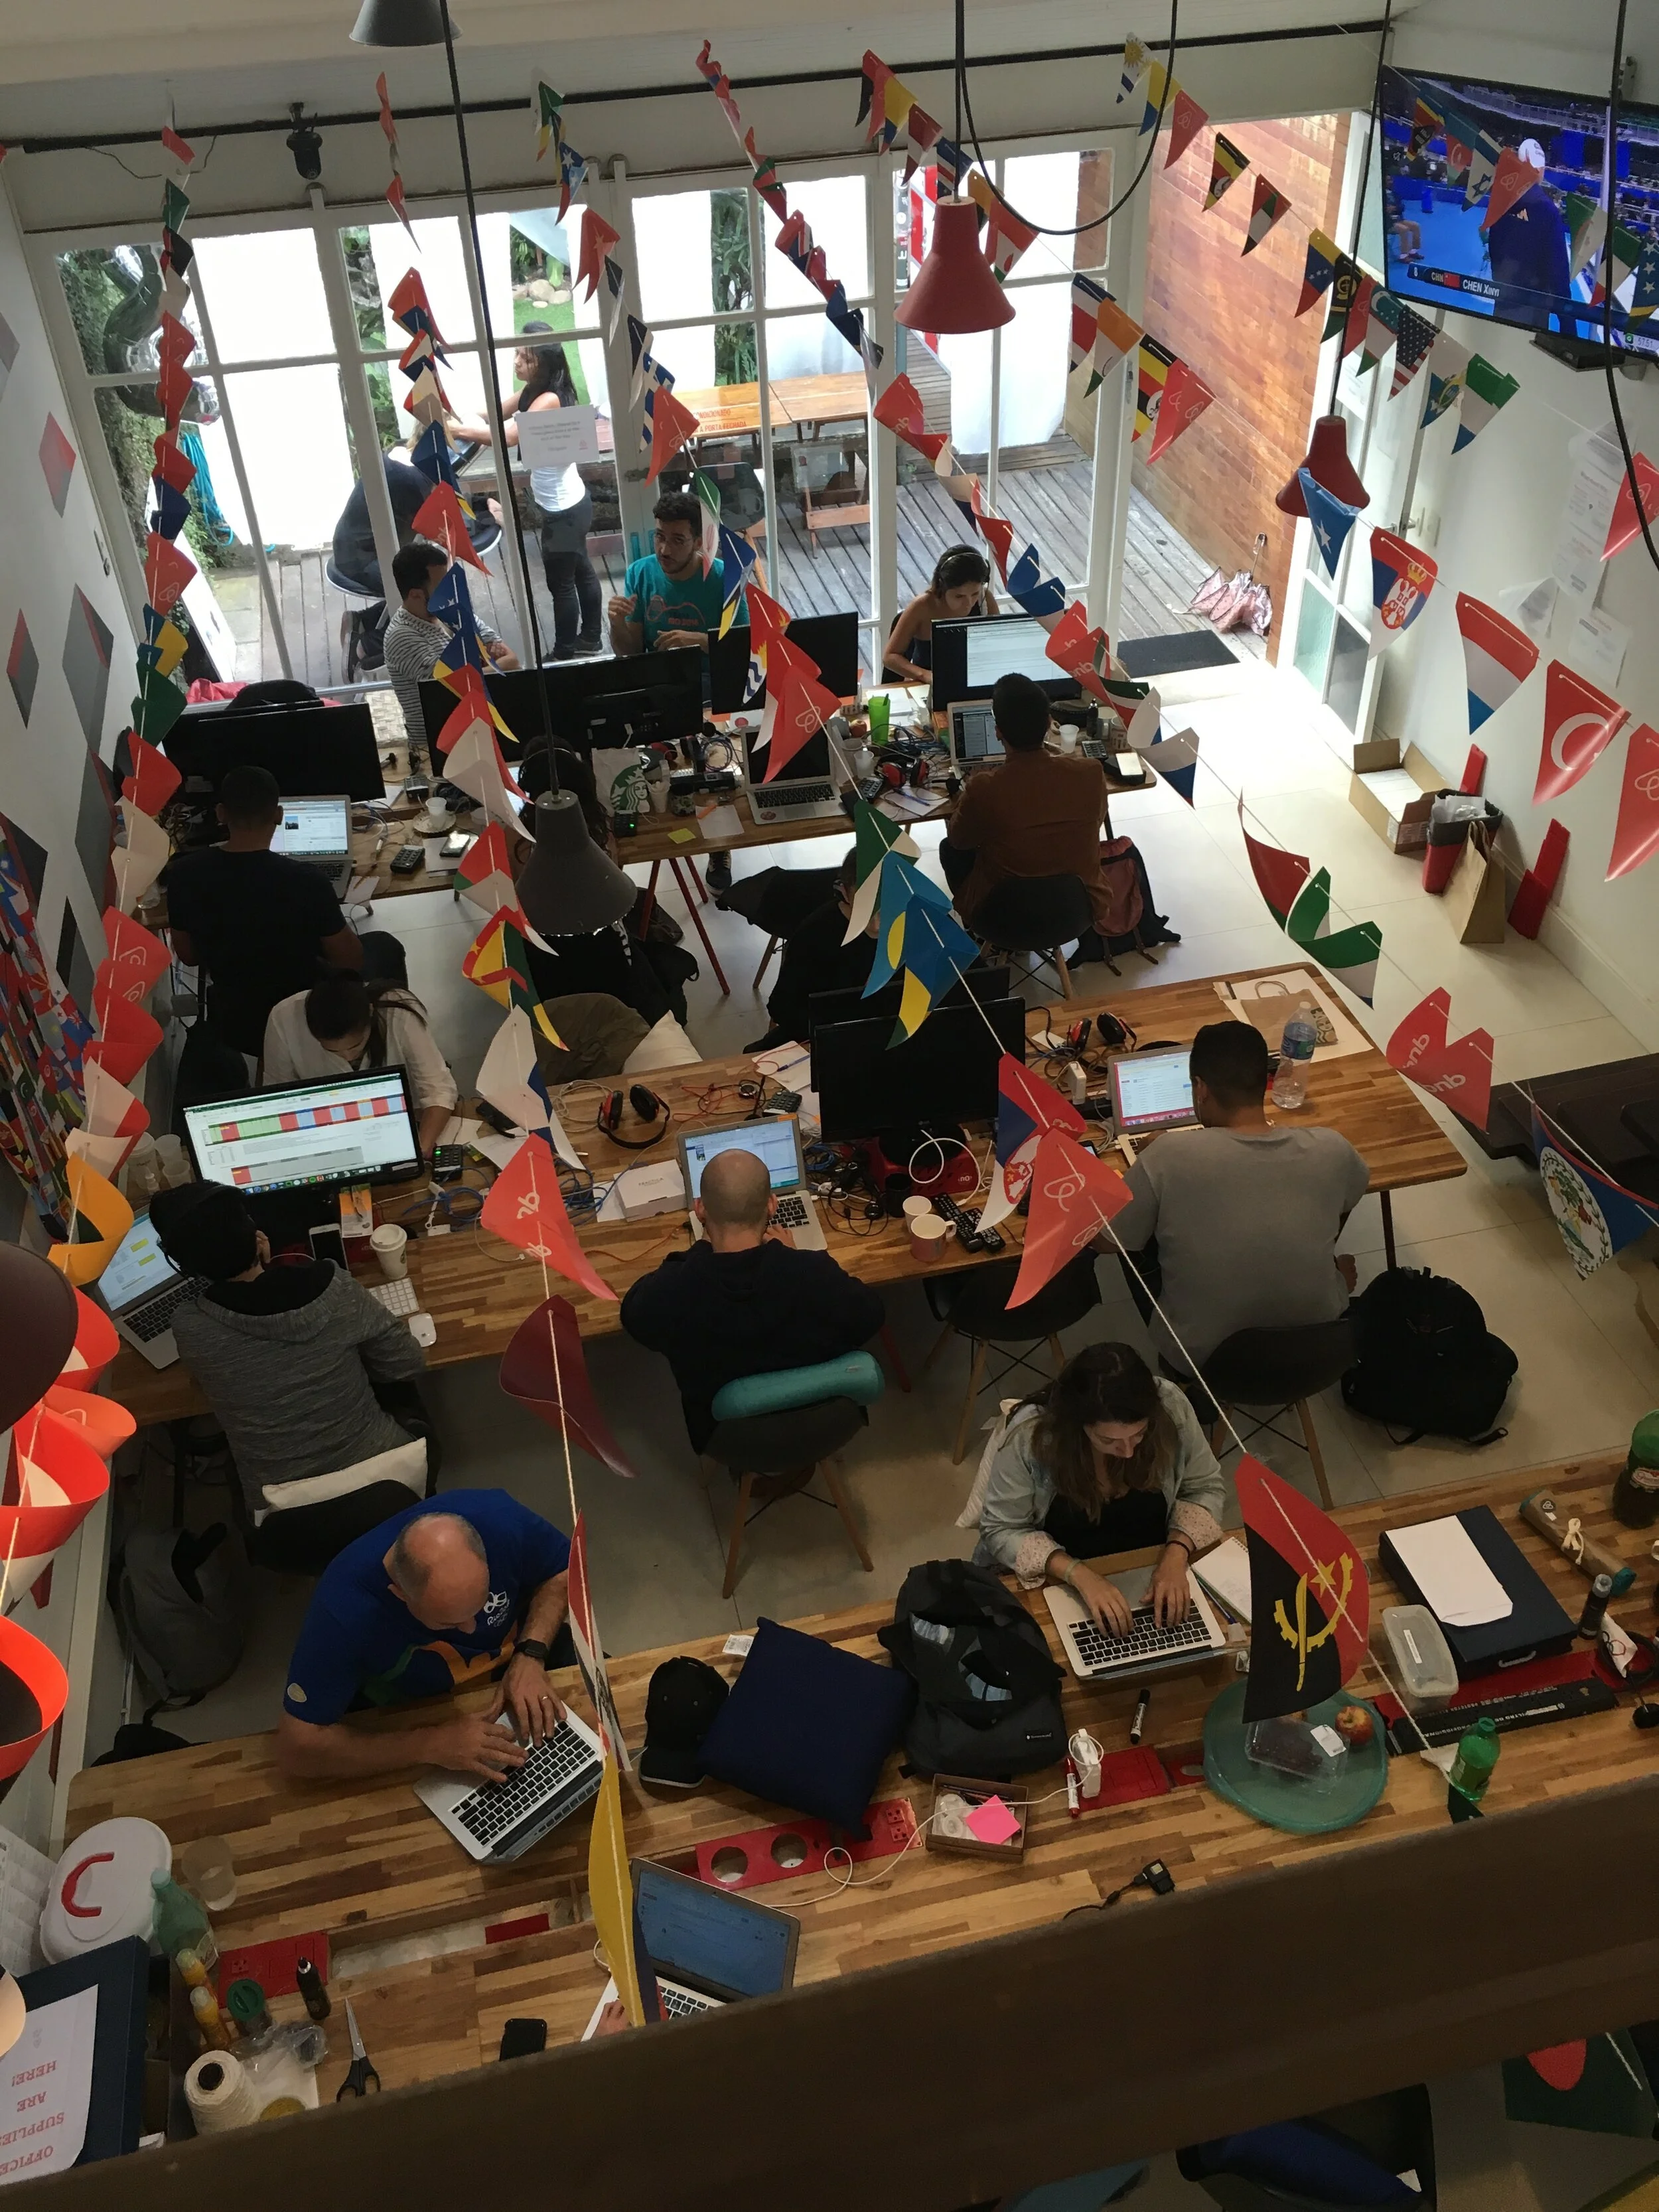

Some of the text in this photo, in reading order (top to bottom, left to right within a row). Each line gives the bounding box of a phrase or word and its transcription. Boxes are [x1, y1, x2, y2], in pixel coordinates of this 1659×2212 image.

[1413, 267, 1418, 277] 8
[1431, 271, 1444, 283] CHN
[1463, 279, 1482, 293] CHEN
[723, 421, 747, 429] FECHADA
[11, 2060, 57, 2087] HERE!
[17, 2091, 47, 2112] ARE
[0, 2112, 64, 2147] SUPPLIE
[0, 2145, 54, 2176] OFFICE
